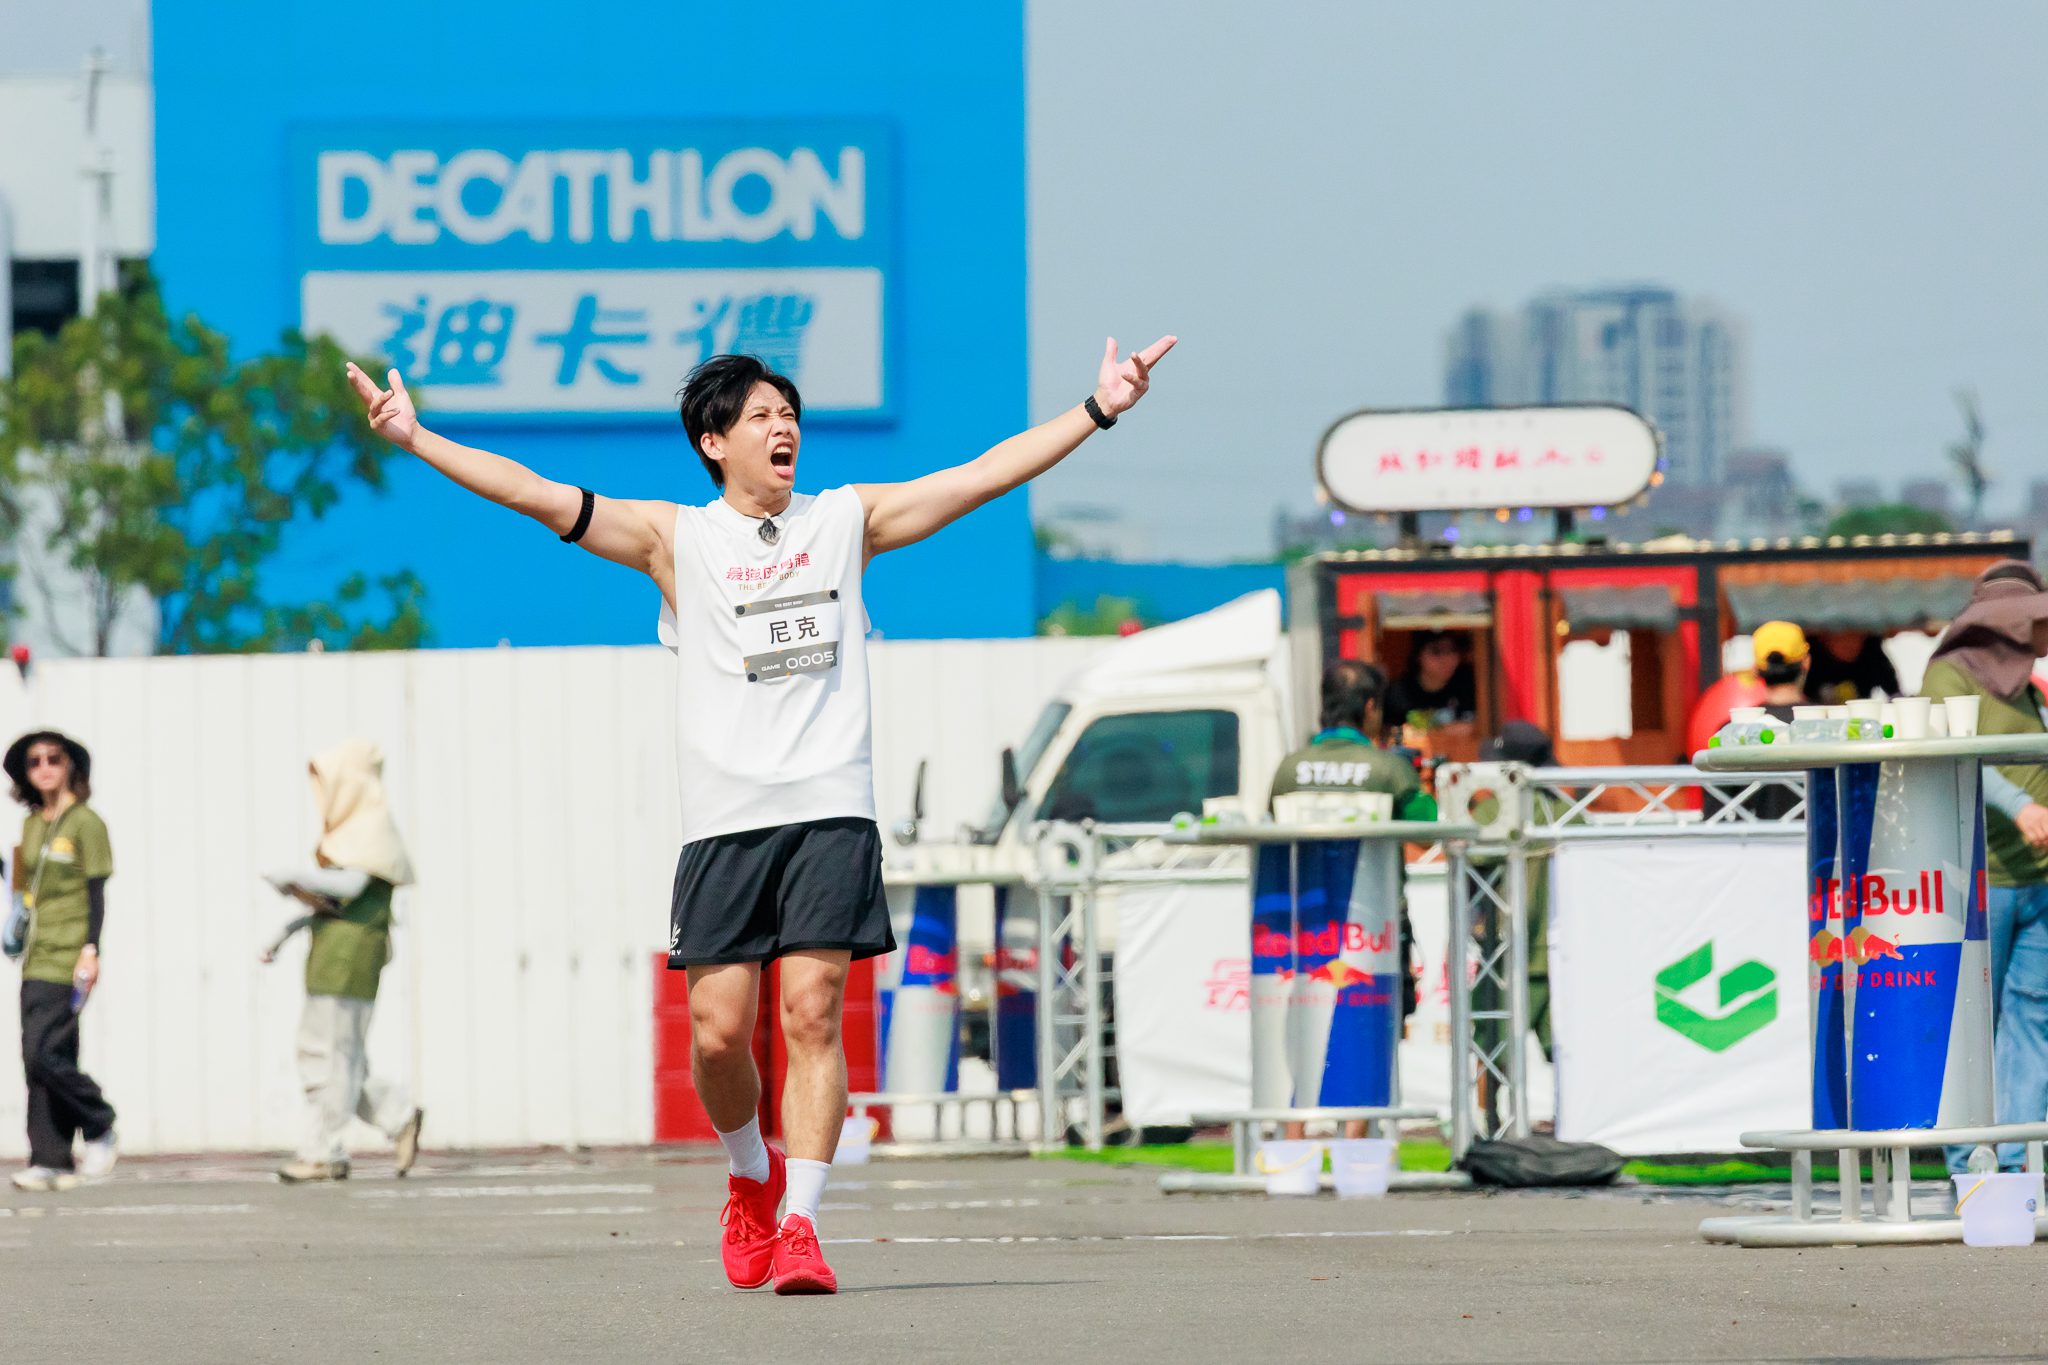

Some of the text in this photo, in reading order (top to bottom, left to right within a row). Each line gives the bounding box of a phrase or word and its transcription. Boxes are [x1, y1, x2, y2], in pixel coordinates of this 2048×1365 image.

[316, 145, 866, 245] DECATHLON
[769, 615, 820, 644] 尼克
[761, 651, 835, 672] GAME 0005
[1296, 760, 1371, 785] STAFF
[1862, 870, 1944, 916] Bull
[1871, 970, 1936, 988] DRINK
